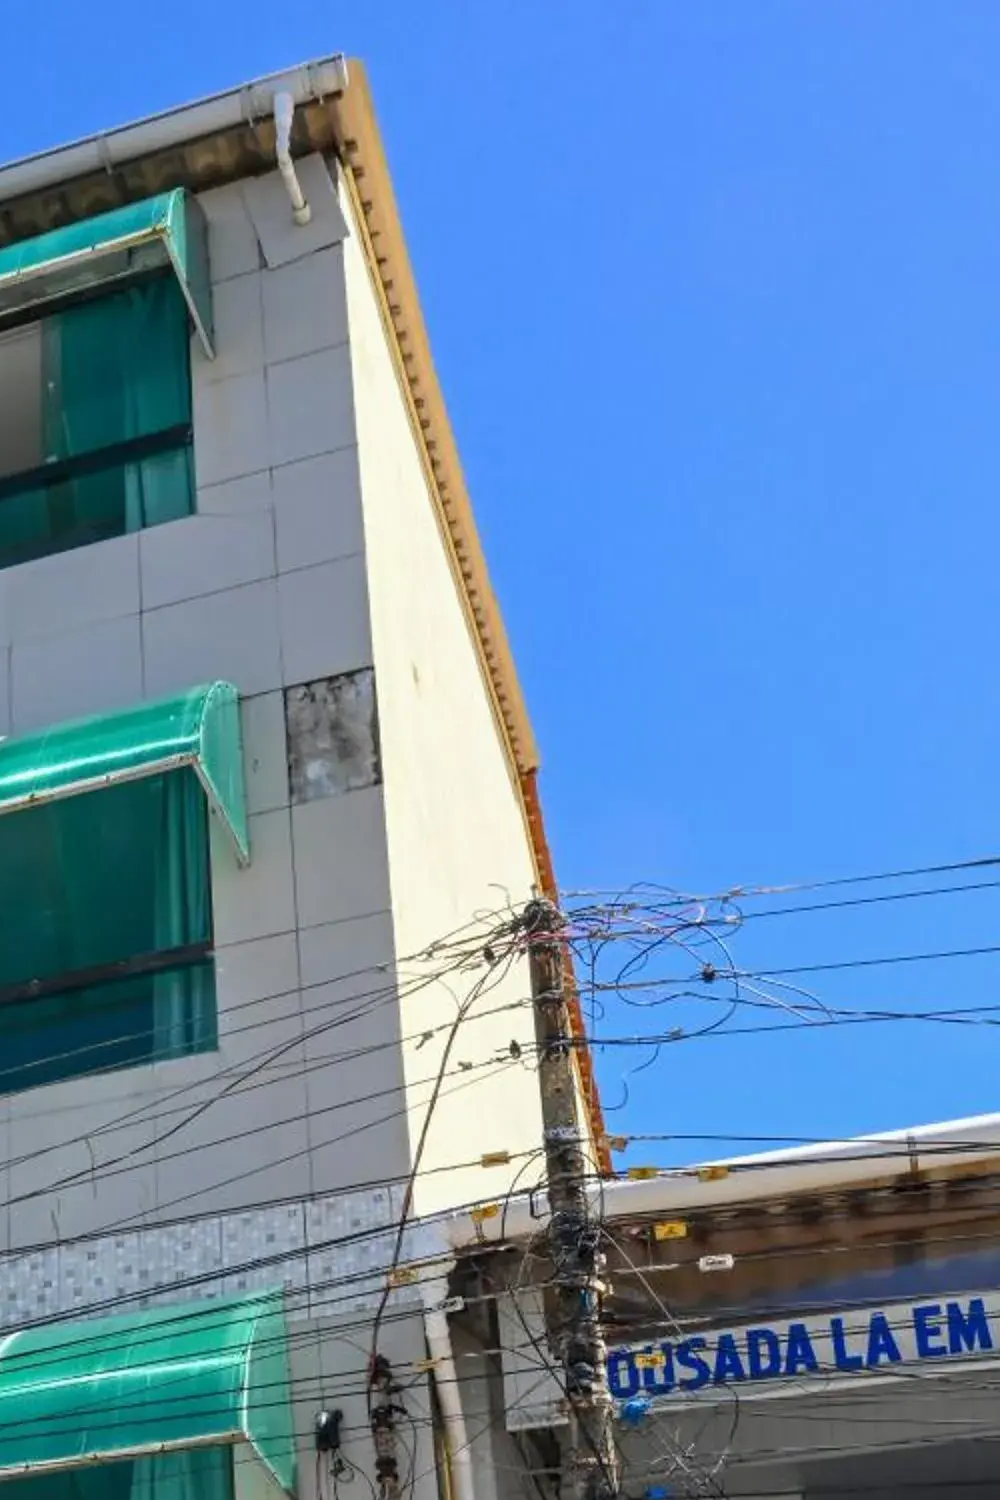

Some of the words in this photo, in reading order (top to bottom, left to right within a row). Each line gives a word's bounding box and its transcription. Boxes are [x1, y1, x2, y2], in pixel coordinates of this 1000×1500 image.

[606, 1322, 819, 1398] OUSADA
[829, 1311, 903, 1371] LA
[912, 1297, 994, 1358] EM
